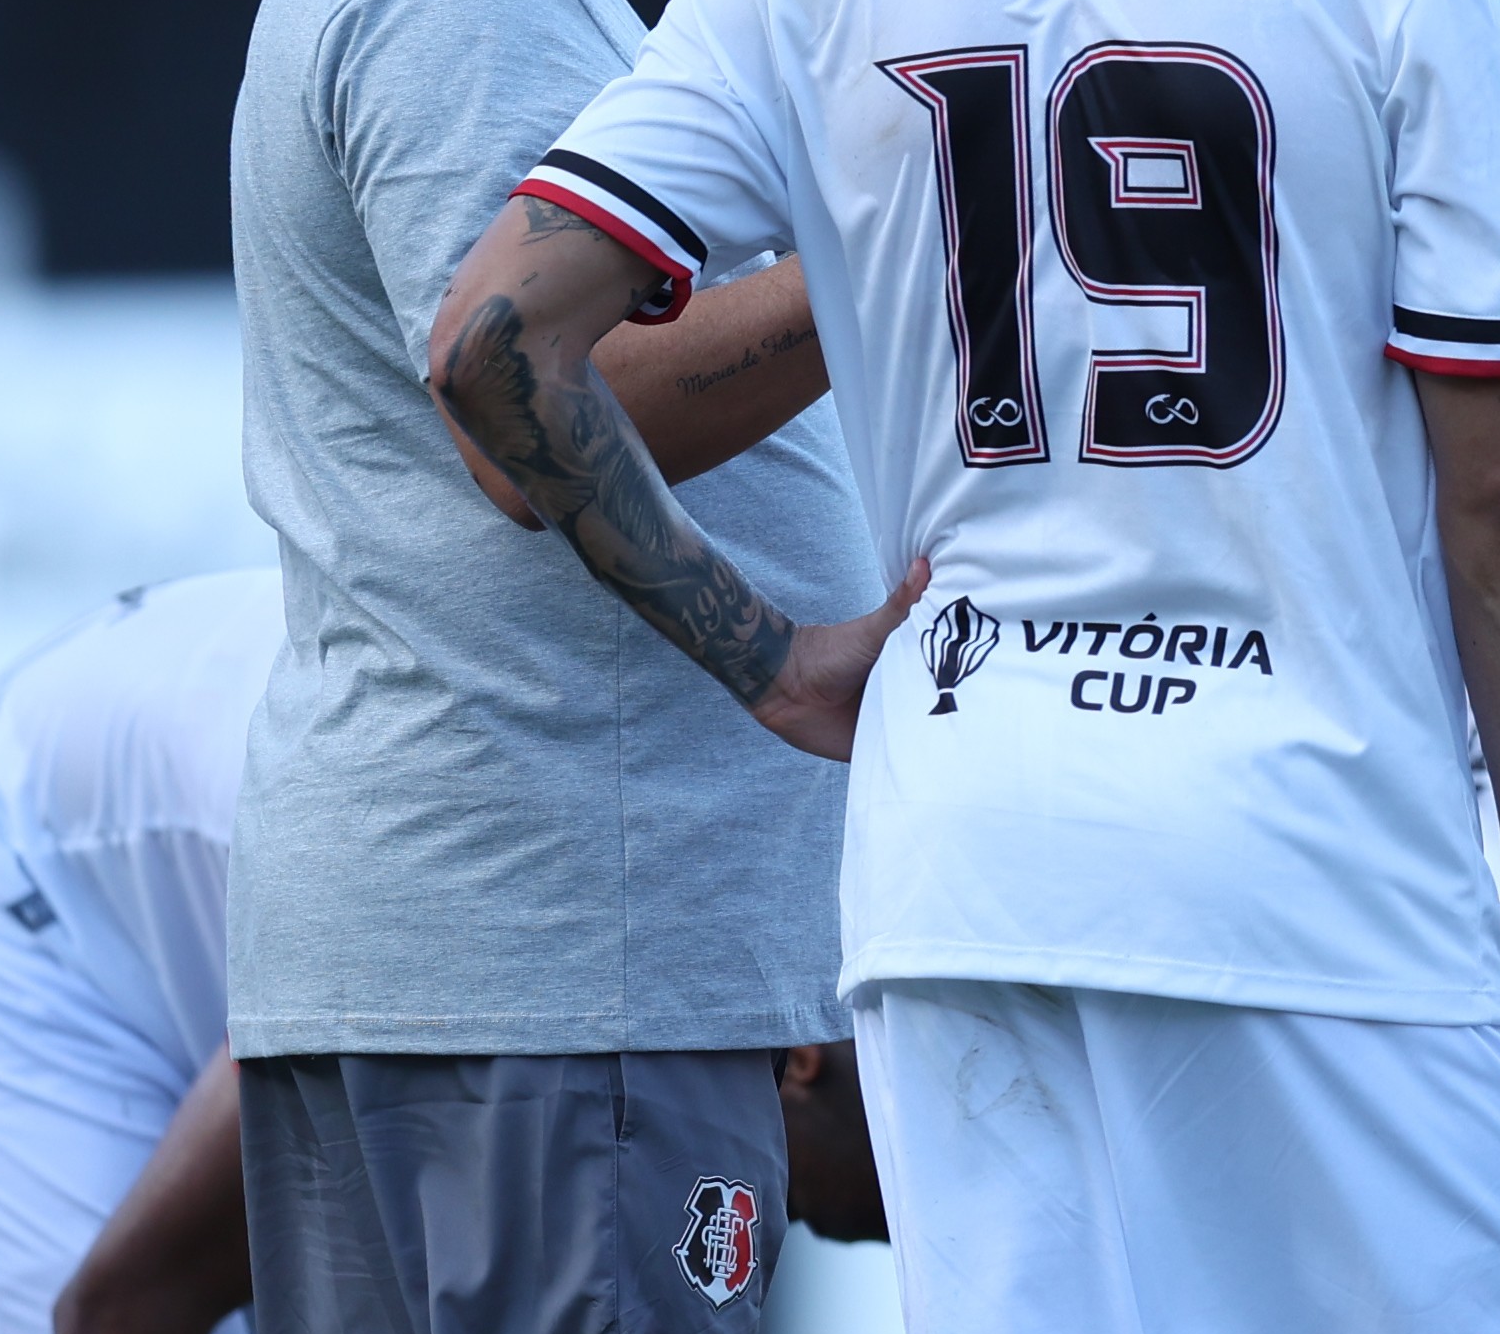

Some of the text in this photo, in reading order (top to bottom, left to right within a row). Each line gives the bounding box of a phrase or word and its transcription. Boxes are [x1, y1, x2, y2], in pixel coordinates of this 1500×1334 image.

[874, 40, 1285, 469] 19
[1022, 613, 1273, 676] VITÓRIA
[1070, 670, 1196, 715] CUP
